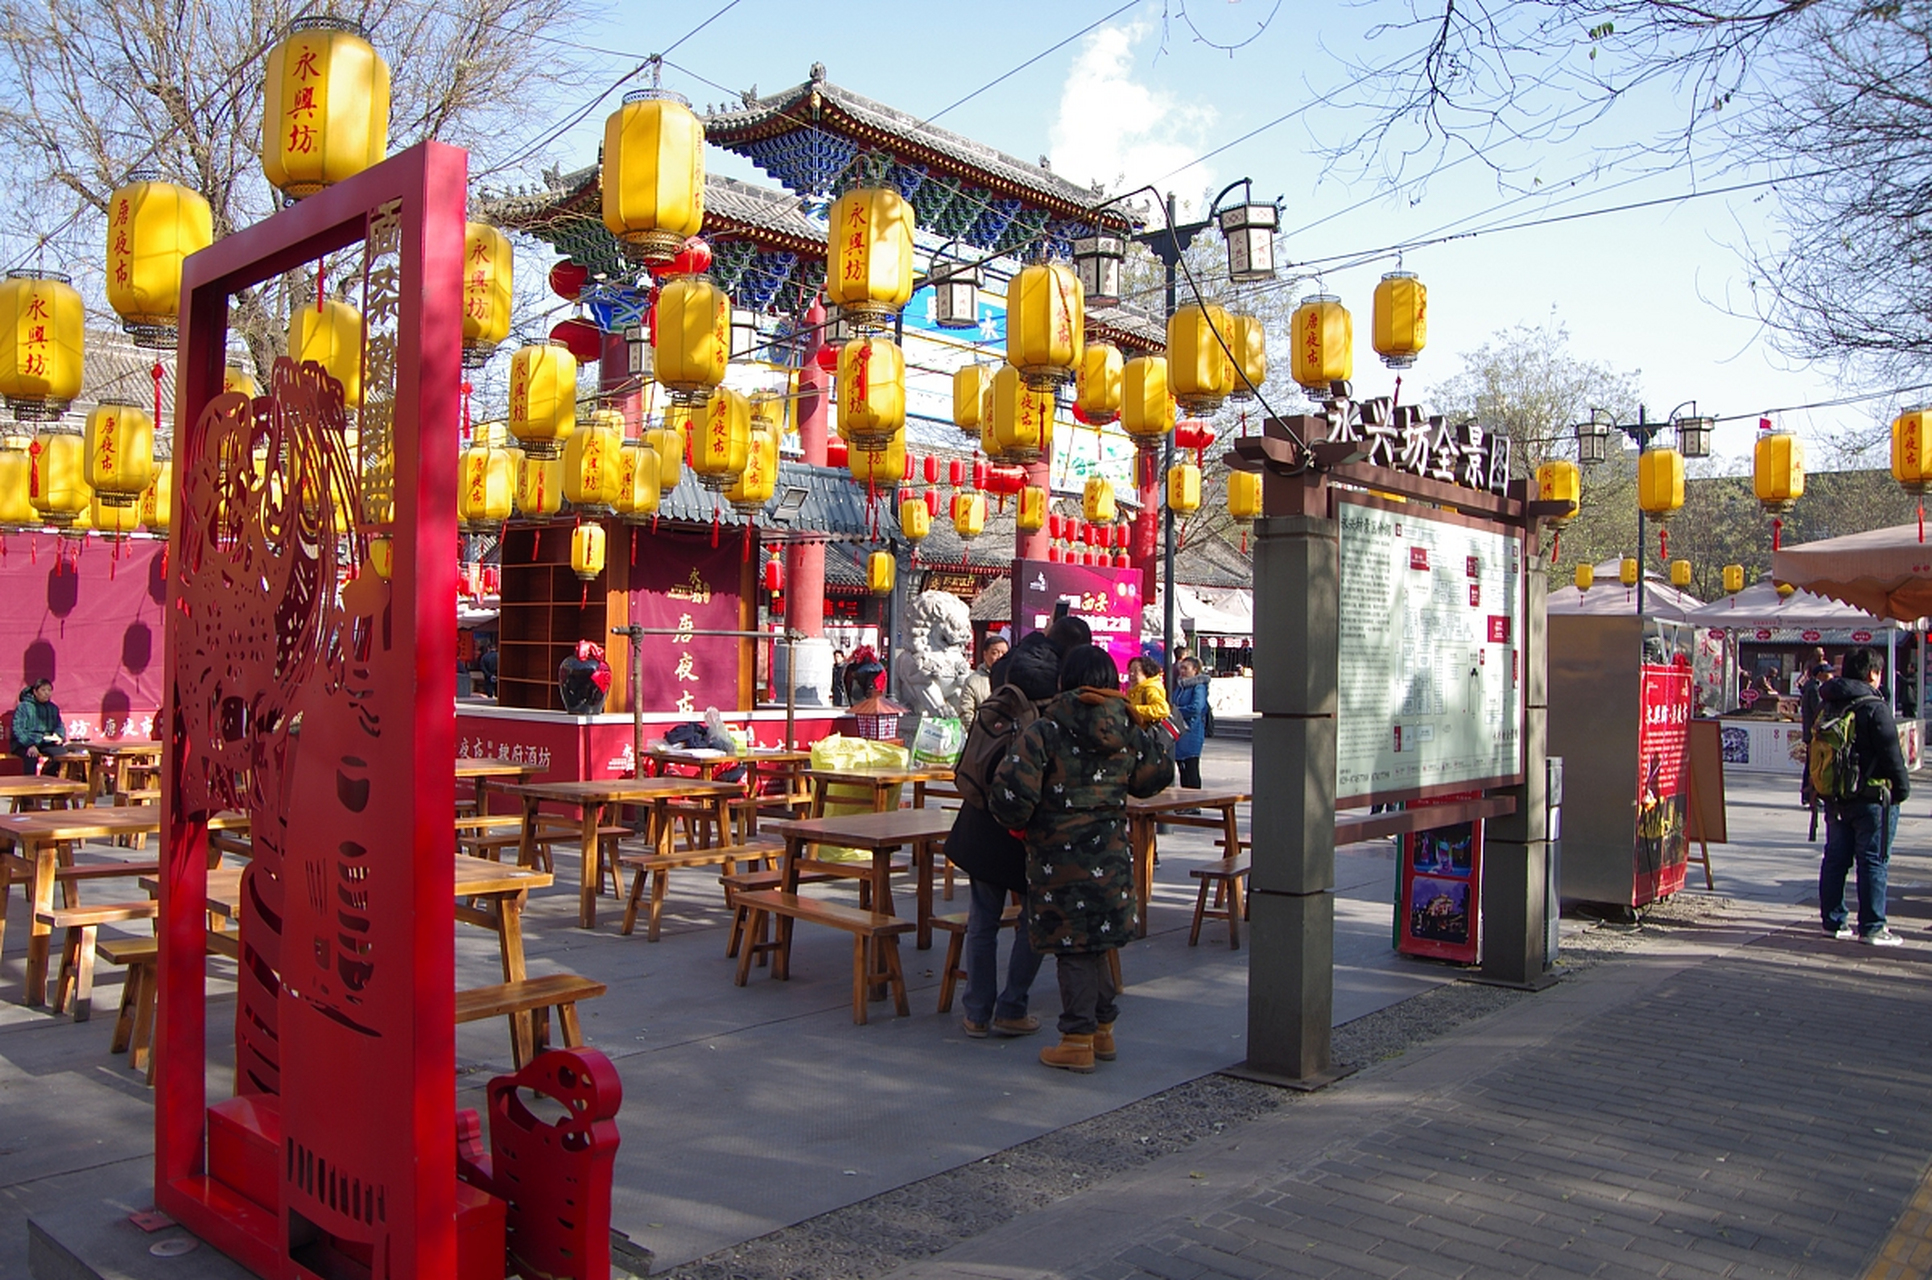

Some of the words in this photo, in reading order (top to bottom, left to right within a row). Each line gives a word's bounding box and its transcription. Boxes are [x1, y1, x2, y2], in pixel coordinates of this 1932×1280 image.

[287, 45, 320, 154] 永興坊
[113, 199, 131, 288] 唐夜市
[466, 238, 490, 319] 永興坊
[844, 202, 866, 281] 永興坊
[23, 294, 49, 376] 永興坊
[1305, 312, 1320, 367] 唐夜市
[513, 358, 526, 422] 永興坊
[712, 400, 727, 456] 唐夜市
[101, 417, 116, 474] 唐夜市
[1327, 396, 1511, 497] 永兴坊全景图
[1904, 420, 1919, 467] 唐夜市
[672, 613, 699, 713] 唐夜市
